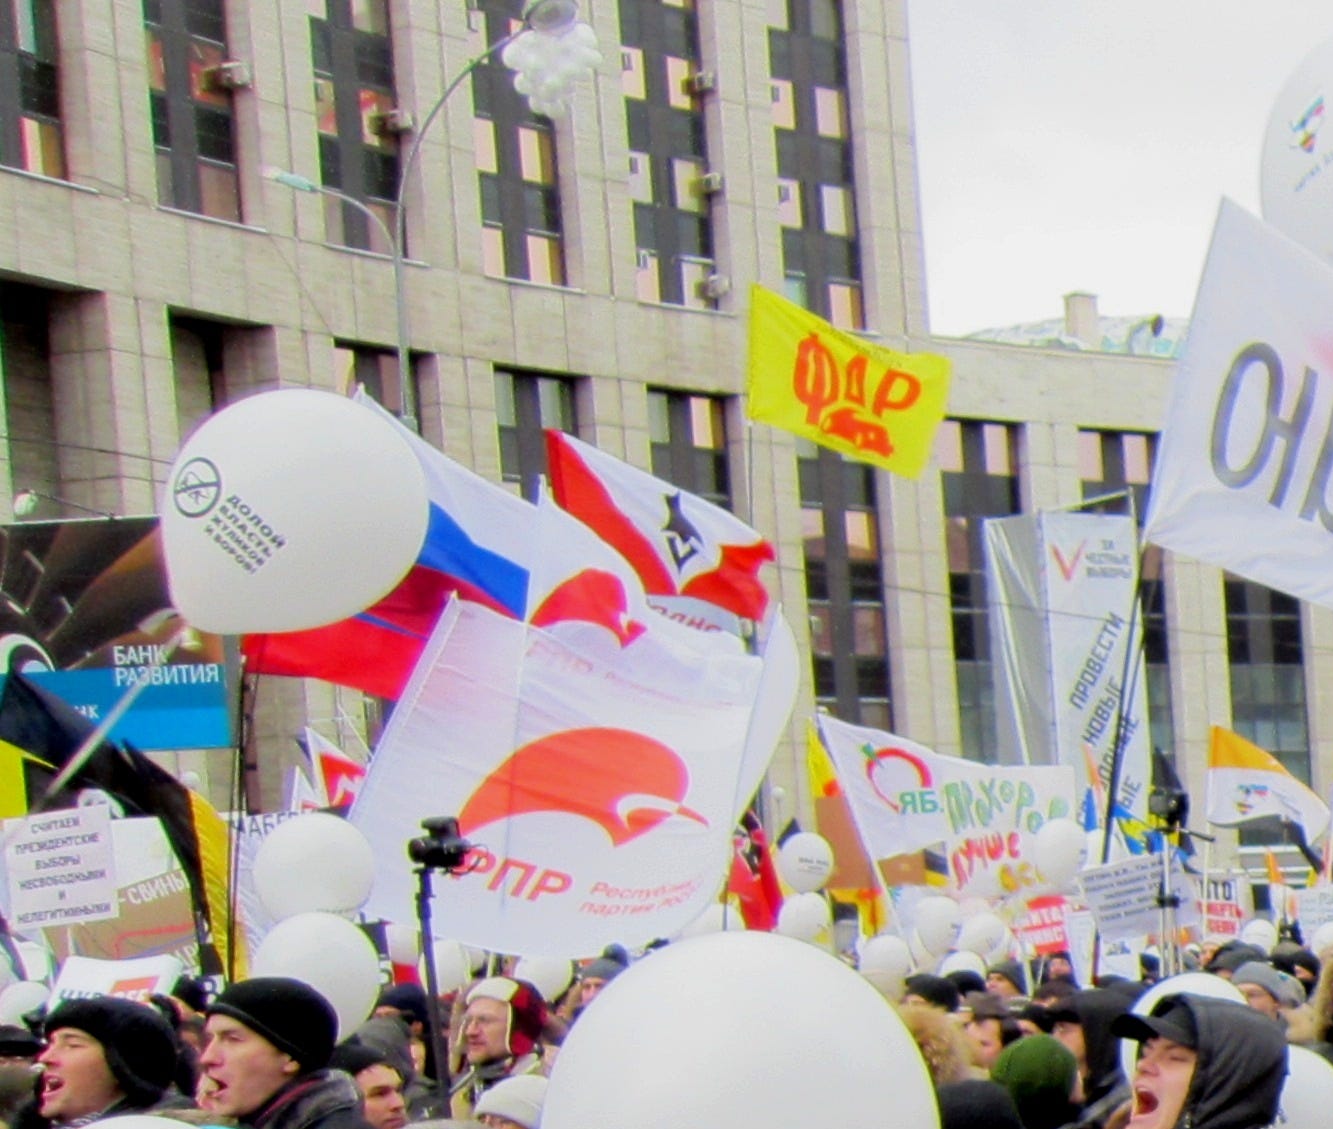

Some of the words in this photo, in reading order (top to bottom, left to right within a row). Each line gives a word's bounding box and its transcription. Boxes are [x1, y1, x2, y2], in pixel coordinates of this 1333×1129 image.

[226, 495, 286, 549] ДОЛОЙ
[113, 645, 169, 666] БАНК
[1069, 611, 1125, 711] ПРОВЕСТИ
[115, 664, 220, 687] РАЗВИТИЯ
[31, 815, 80, 834] СЧИТАЕМ
[15, 832, 99, 854] ПРЕЗИДЕНТСКИЕ
[35, 854, 81, 870] ВЫБОРЫ
[451, 846, 573, 902] РПР
